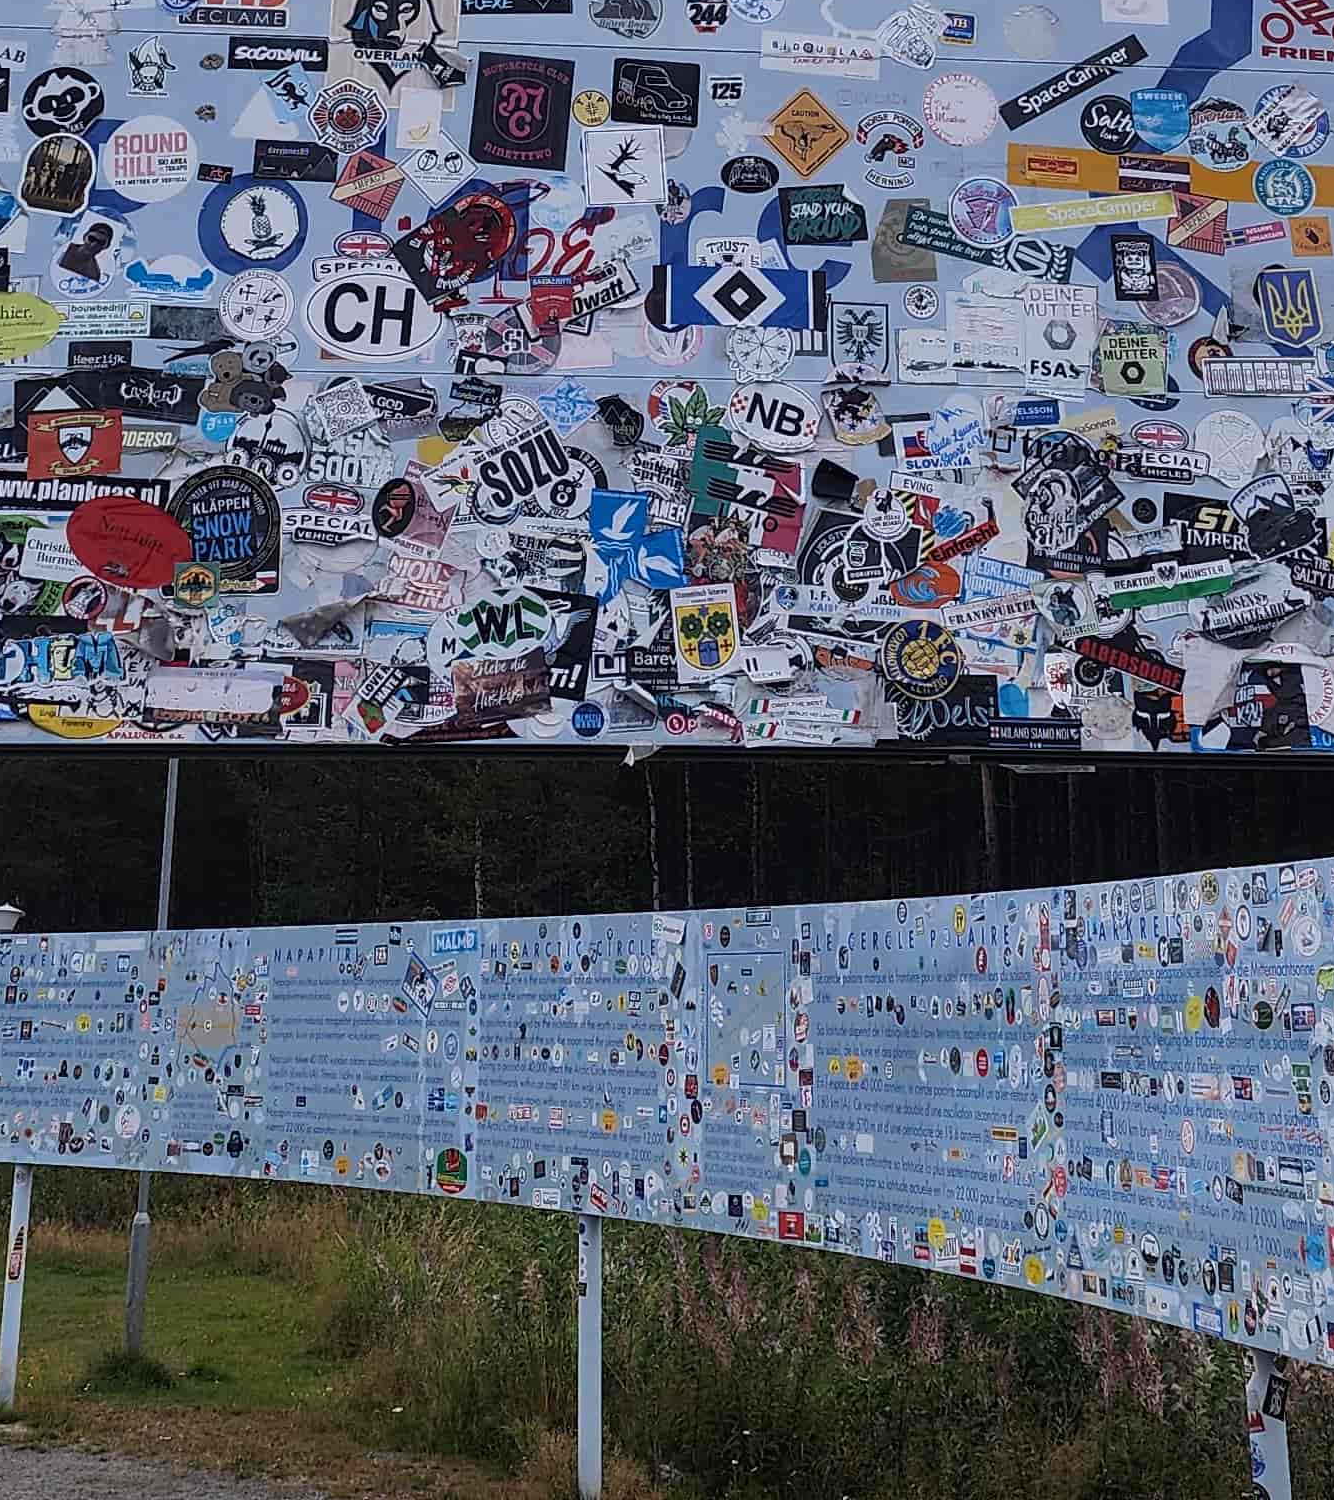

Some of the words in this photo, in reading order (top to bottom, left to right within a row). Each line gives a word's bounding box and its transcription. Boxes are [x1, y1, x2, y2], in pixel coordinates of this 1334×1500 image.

[181, 10, 285, 25] RECLAME
[711, 82, 741, 99] 125
[1019, 45, 1129, 114] SpaceCamper
[115, 132, 187, 154] ROUND
[115, 155, 155, 176] HILL
[1, 304, 33, 320] hier.
[325, 285, 413, 345] CH
[1109, 338, 1148, 350] DEINE
[1103, 349, 1158, 362] MUTTER
[747, 400, 805, 435] NB
[479, 440, 569, 505] SOZU
[193, 513, 251, 539] SNOW
[194, 538, 252, 561] PARK
[475, 605, 537, 640] WL
[930, 930, 1010, 949] PLAIRE
[1060, 919, 1182, 943] PLARKREIS
